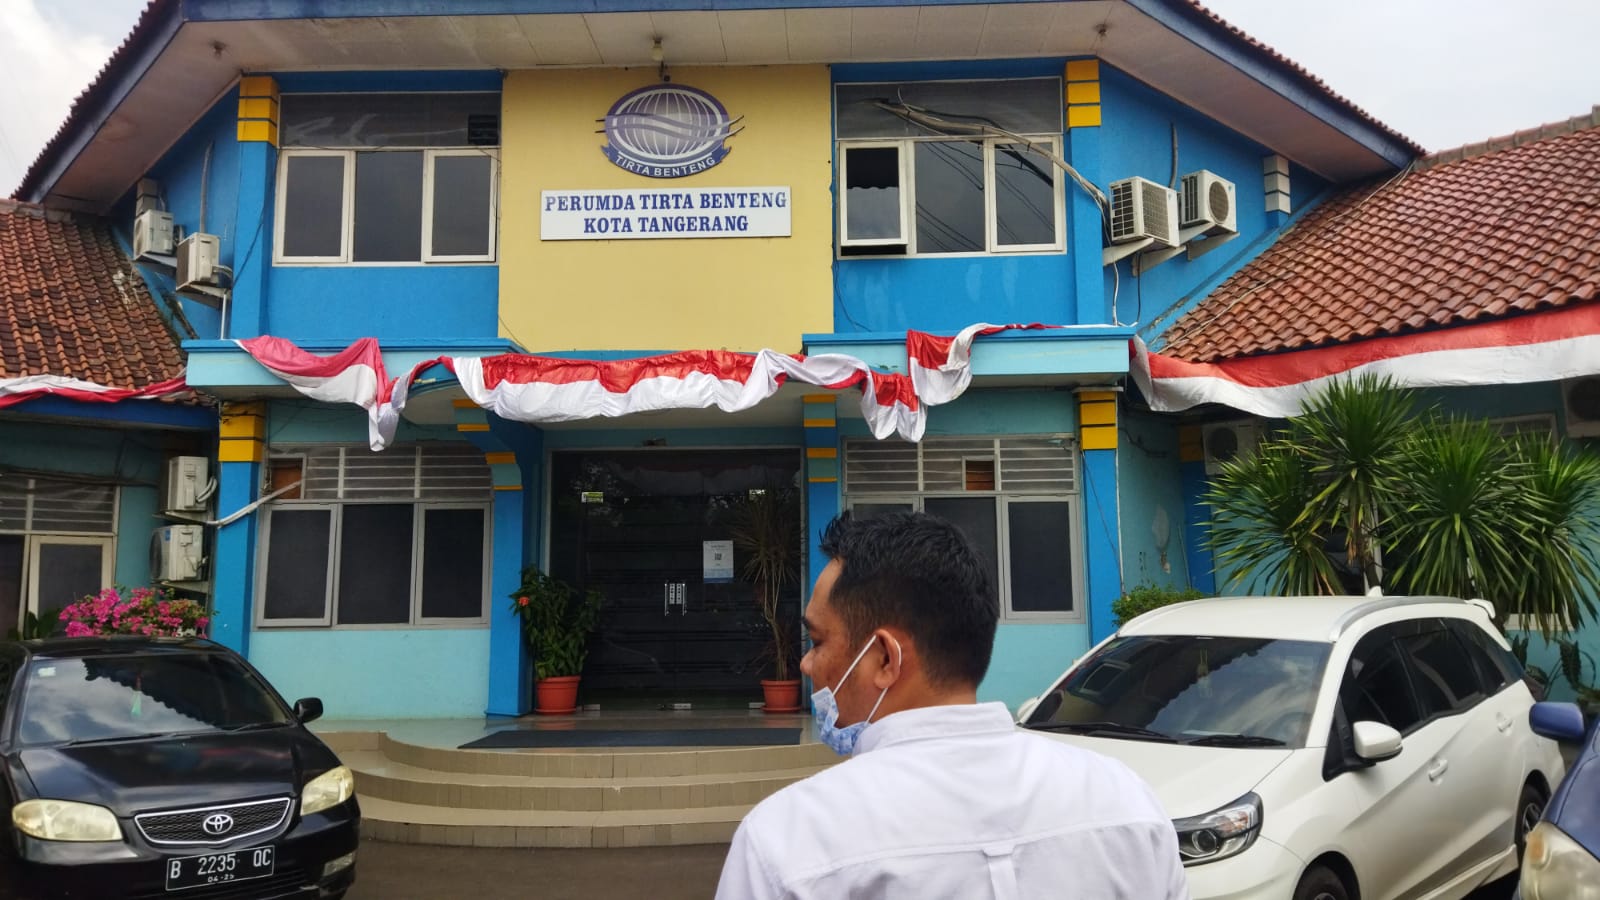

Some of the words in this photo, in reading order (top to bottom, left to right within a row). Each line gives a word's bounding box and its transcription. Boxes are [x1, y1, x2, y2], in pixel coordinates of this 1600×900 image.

[615, 155, 650, 176] TIRTA
[654, 157, 716, 177] BENTENG
[545, 194, 635, 212] PERUMDA
[640, 193, 694, 210] TIRTA
[699, 191, 787, 209] BENTENG
[583, 217, 633, 234] KOTA
[638, 215, 748, 233] TANGERANG
[170, 860, 181, 879] B
[197, 853, 236, 875] 2235
[253, 848, 271, 867] QC
